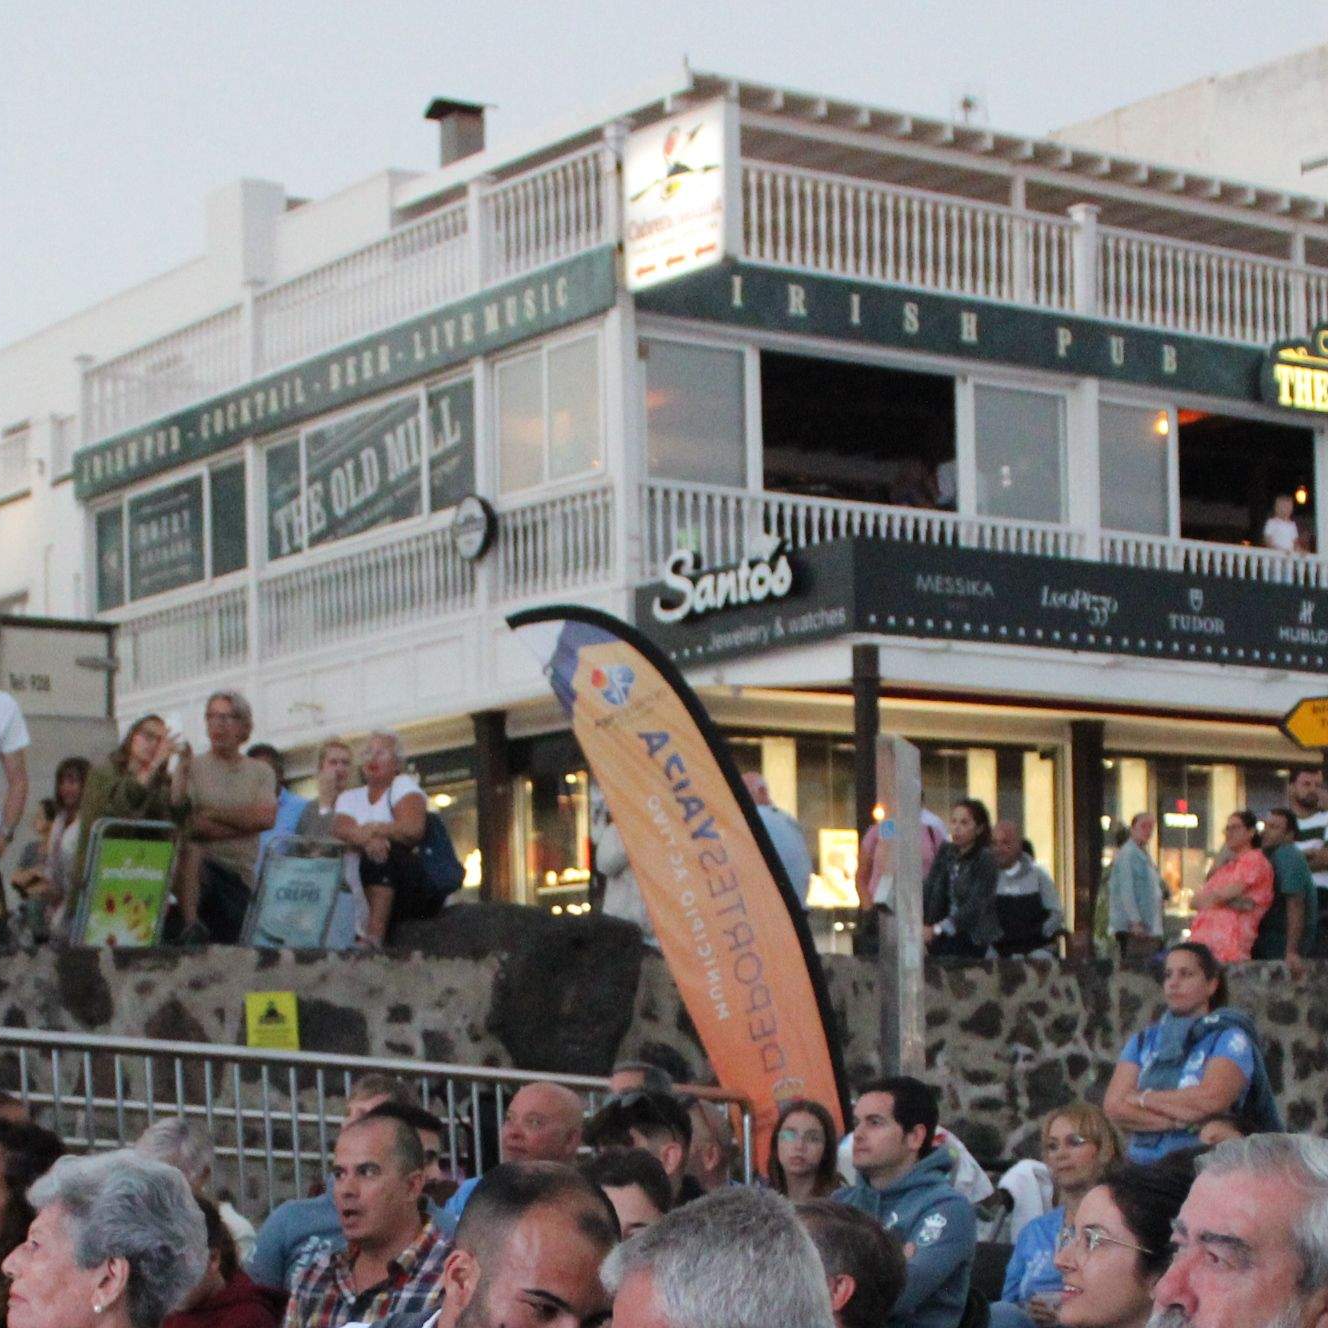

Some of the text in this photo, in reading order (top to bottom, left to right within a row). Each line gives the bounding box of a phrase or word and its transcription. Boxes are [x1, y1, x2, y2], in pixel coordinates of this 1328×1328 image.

[329, 344, 390, 392] BEER
[414, 312, 474, 361] LIVE
[484, 276, 568, 334] MUSIC
[732, 274, 1177, 375] IRISH PUB
[330, 446, 380, 520] OLD
[652, 548, 793, 624] Santos
[916, 574, 995, 599] MESSIKA
[1169, 613, 1225, 635] TUDOR
